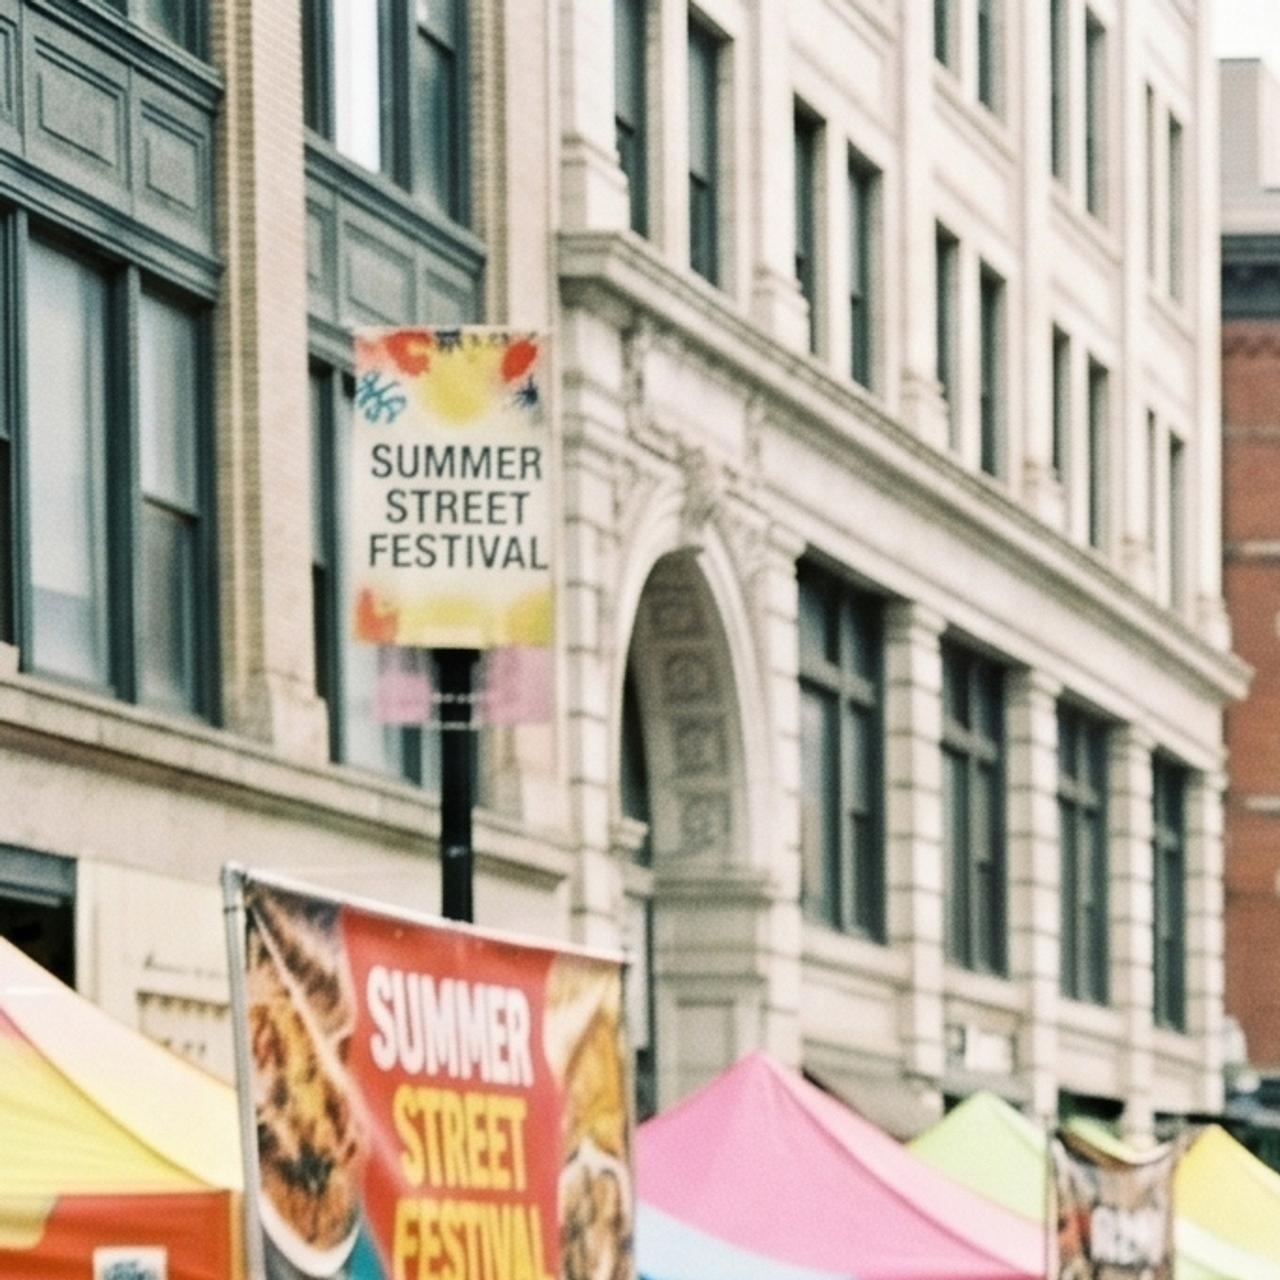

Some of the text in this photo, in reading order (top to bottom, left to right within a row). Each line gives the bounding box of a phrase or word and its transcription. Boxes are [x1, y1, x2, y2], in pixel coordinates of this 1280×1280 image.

[371, 443, 542, 480] SUMMER
[386, 488, 530, 525] STREET
[369, 533, 549, 571] FESTIVAL
[366, 964, 535, 1088] SUMMER
[392, 1082, 528, 1193] STREET
